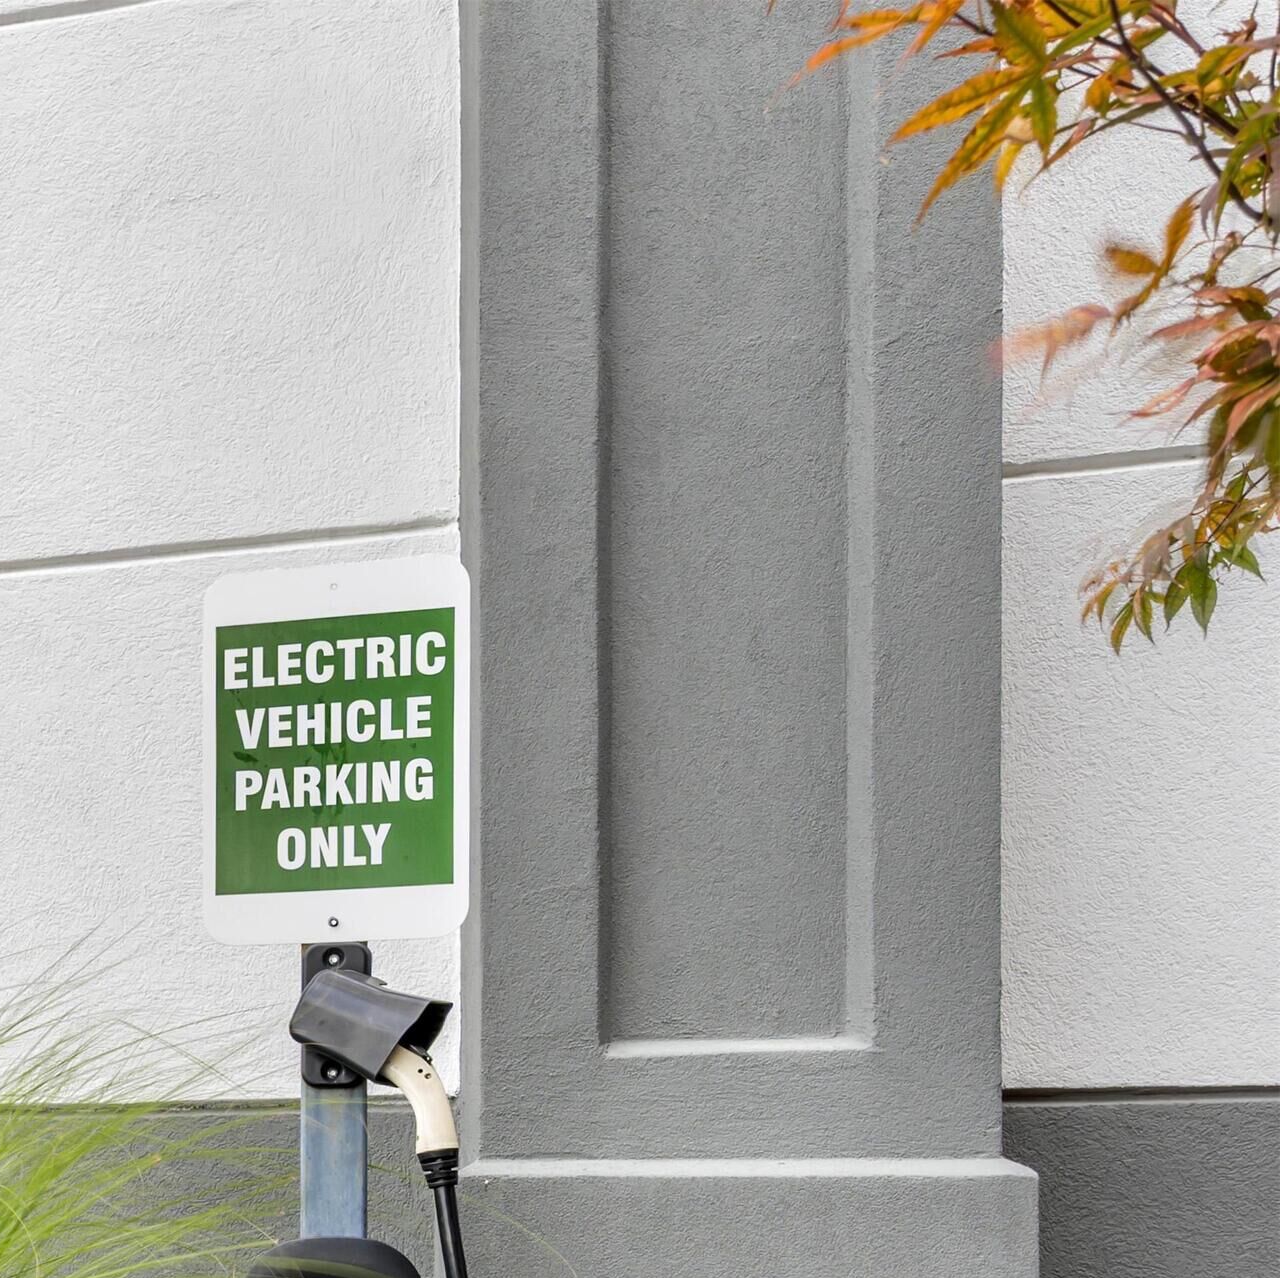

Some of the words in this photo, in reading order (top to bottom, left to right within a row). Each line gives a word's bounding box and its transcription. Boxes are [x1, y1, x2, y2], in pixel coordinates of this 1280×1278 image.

[223, 631, 447, 690] ELECTRIC
[234, 695, 432, 750] VEHICLE
[234, 757, 435, 812] PARKING
[276, 823, 392, 871] ONLY
